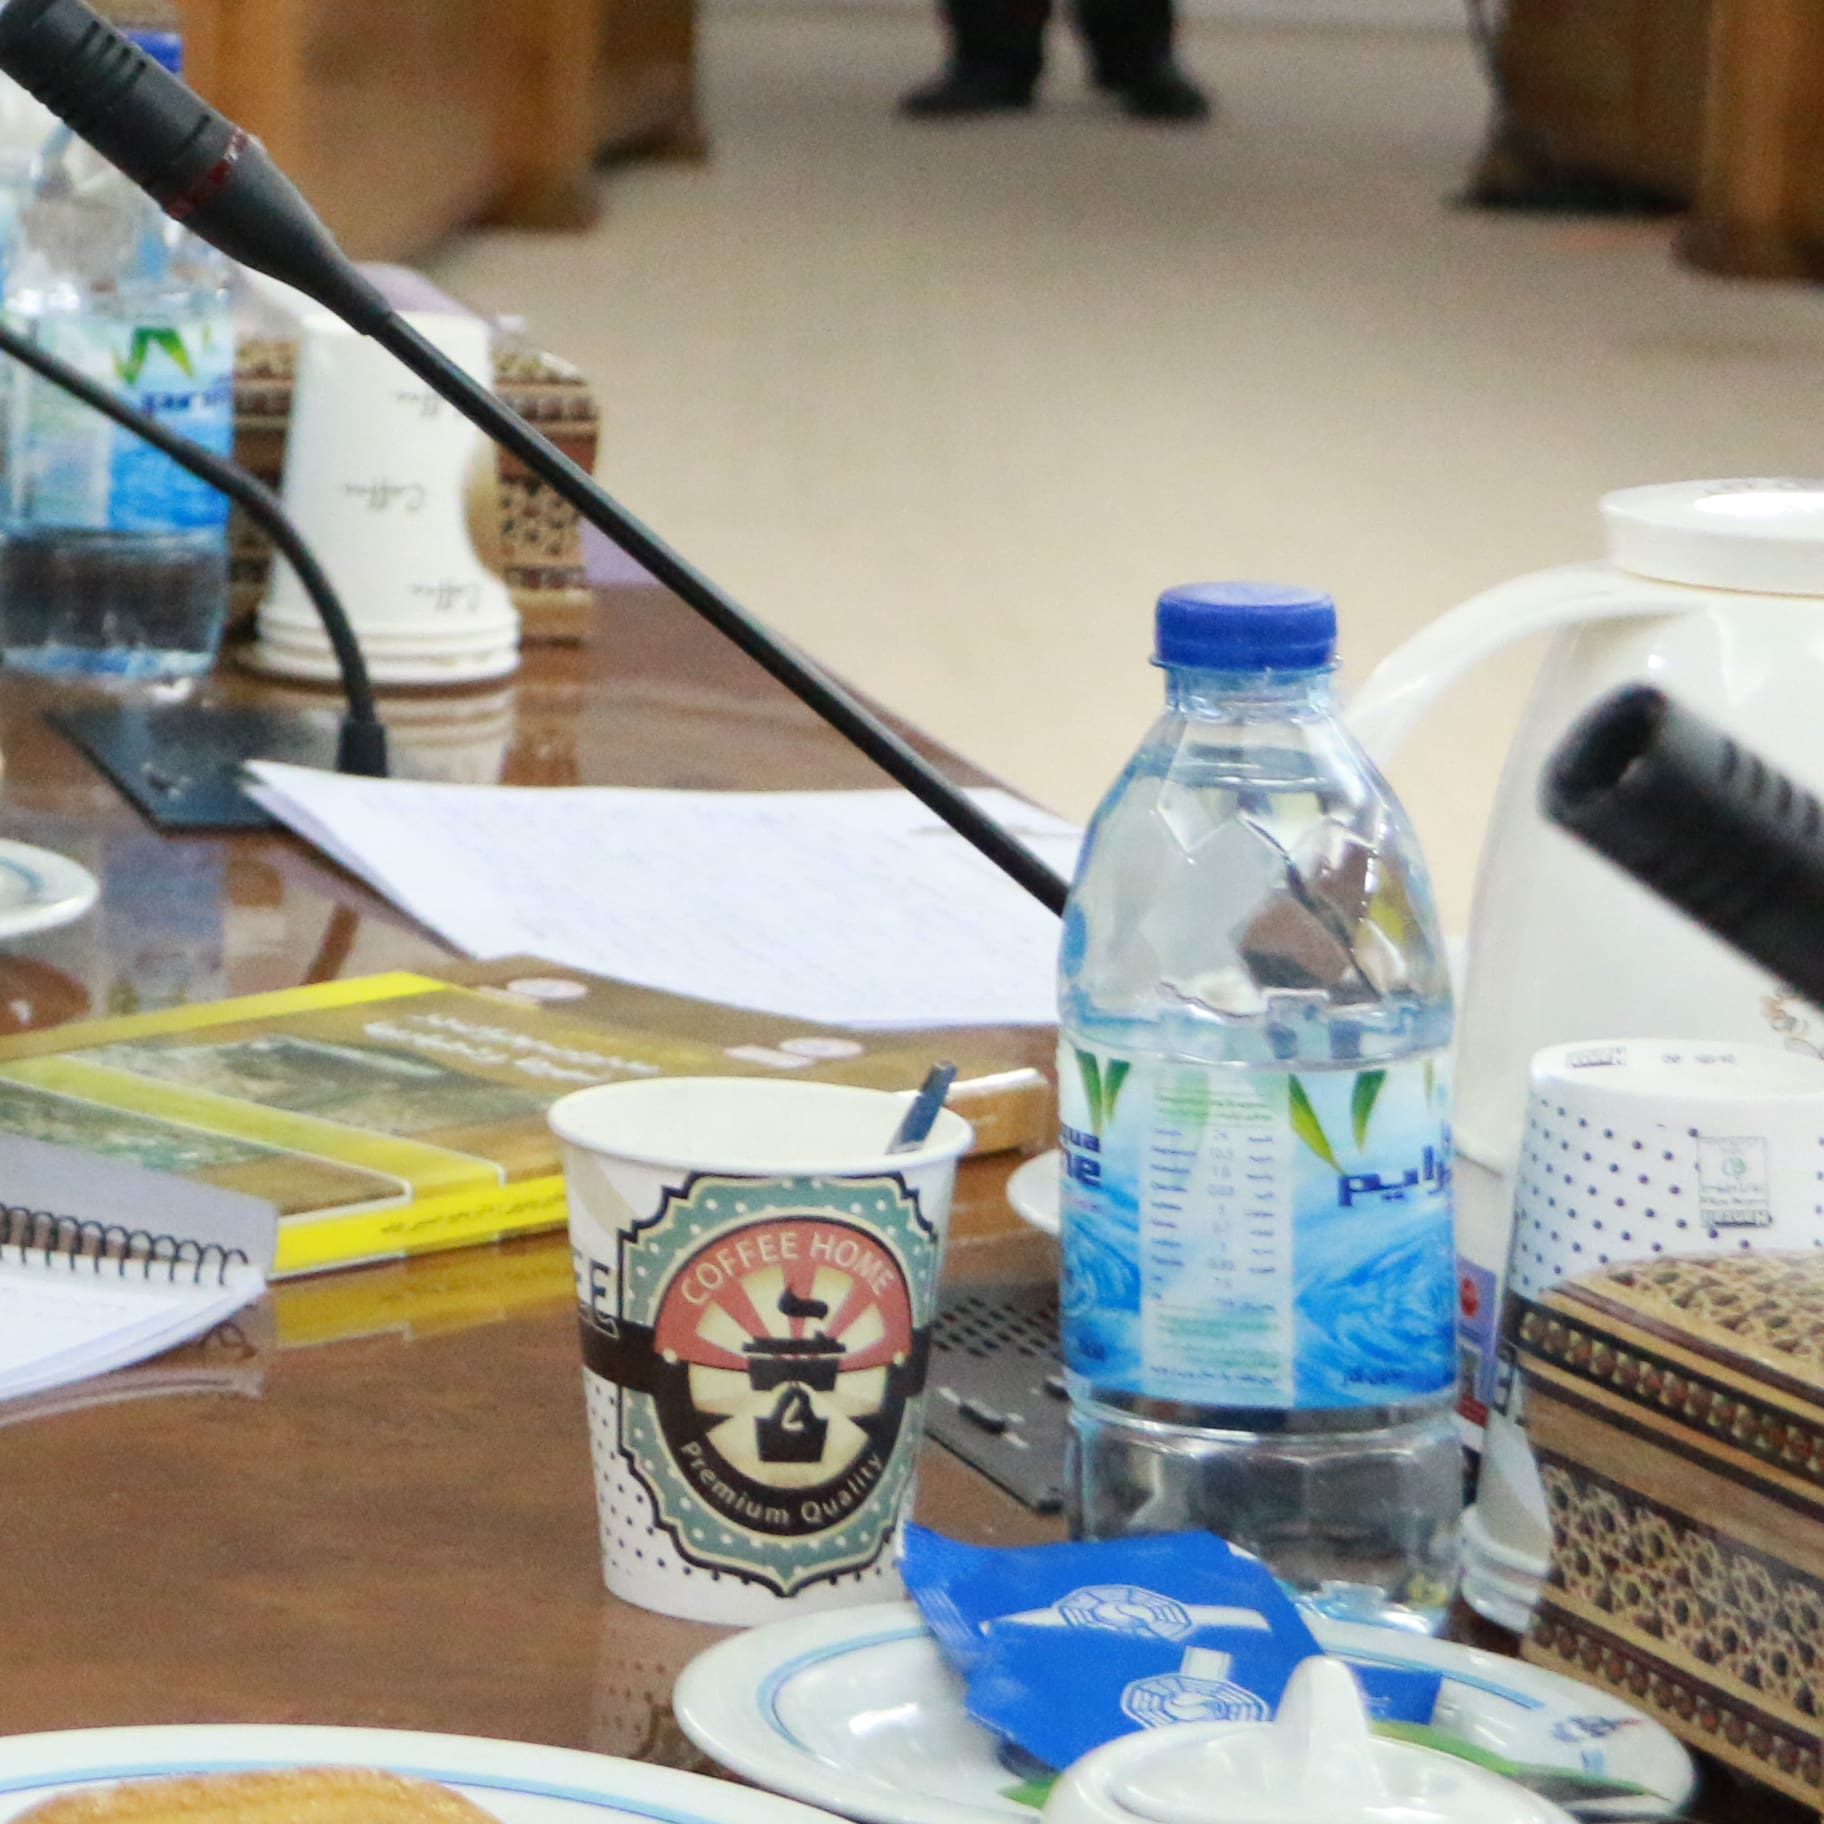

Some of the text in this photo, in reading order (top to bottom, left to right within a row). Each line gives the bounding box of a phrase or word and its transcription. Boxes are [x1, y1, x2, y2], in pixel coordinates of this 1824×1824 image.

[681, 1231, 895, 1305] COFFEE HOME
[680, 1441, 883, 1525] Premium Quality
